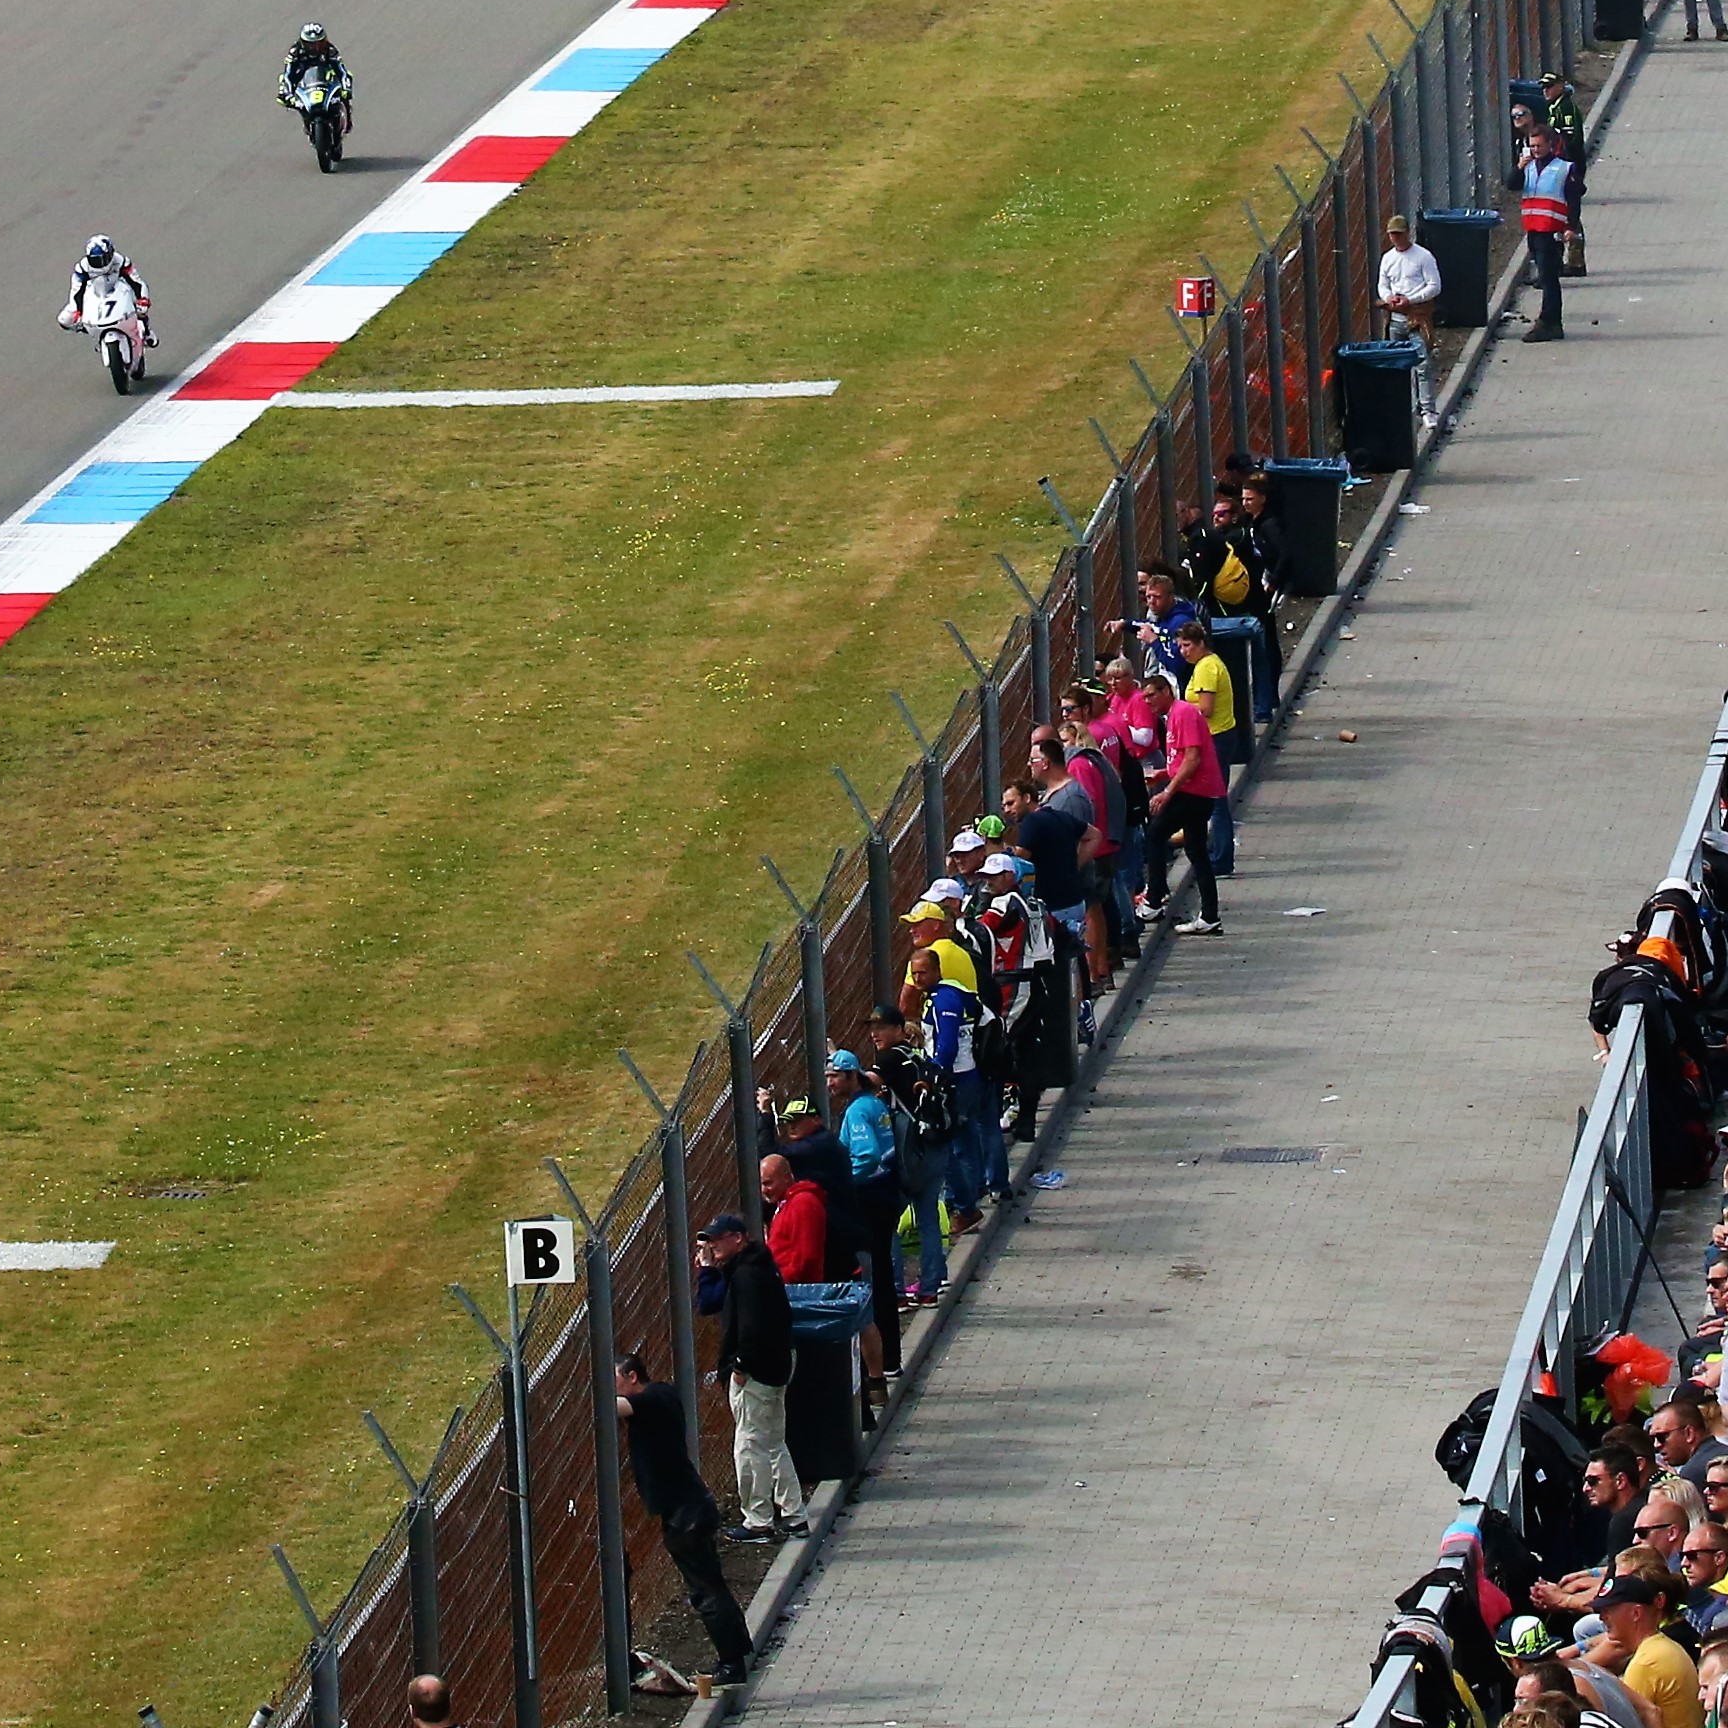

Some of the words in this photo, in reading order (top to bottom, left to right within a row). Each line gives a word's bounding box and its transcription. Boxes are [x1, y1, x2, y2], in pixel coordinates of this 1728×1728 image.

[1182, 282, 1194, 309] F
[1203, 282, 1213, 309] F
[521, 1227, 561, 1280] B
